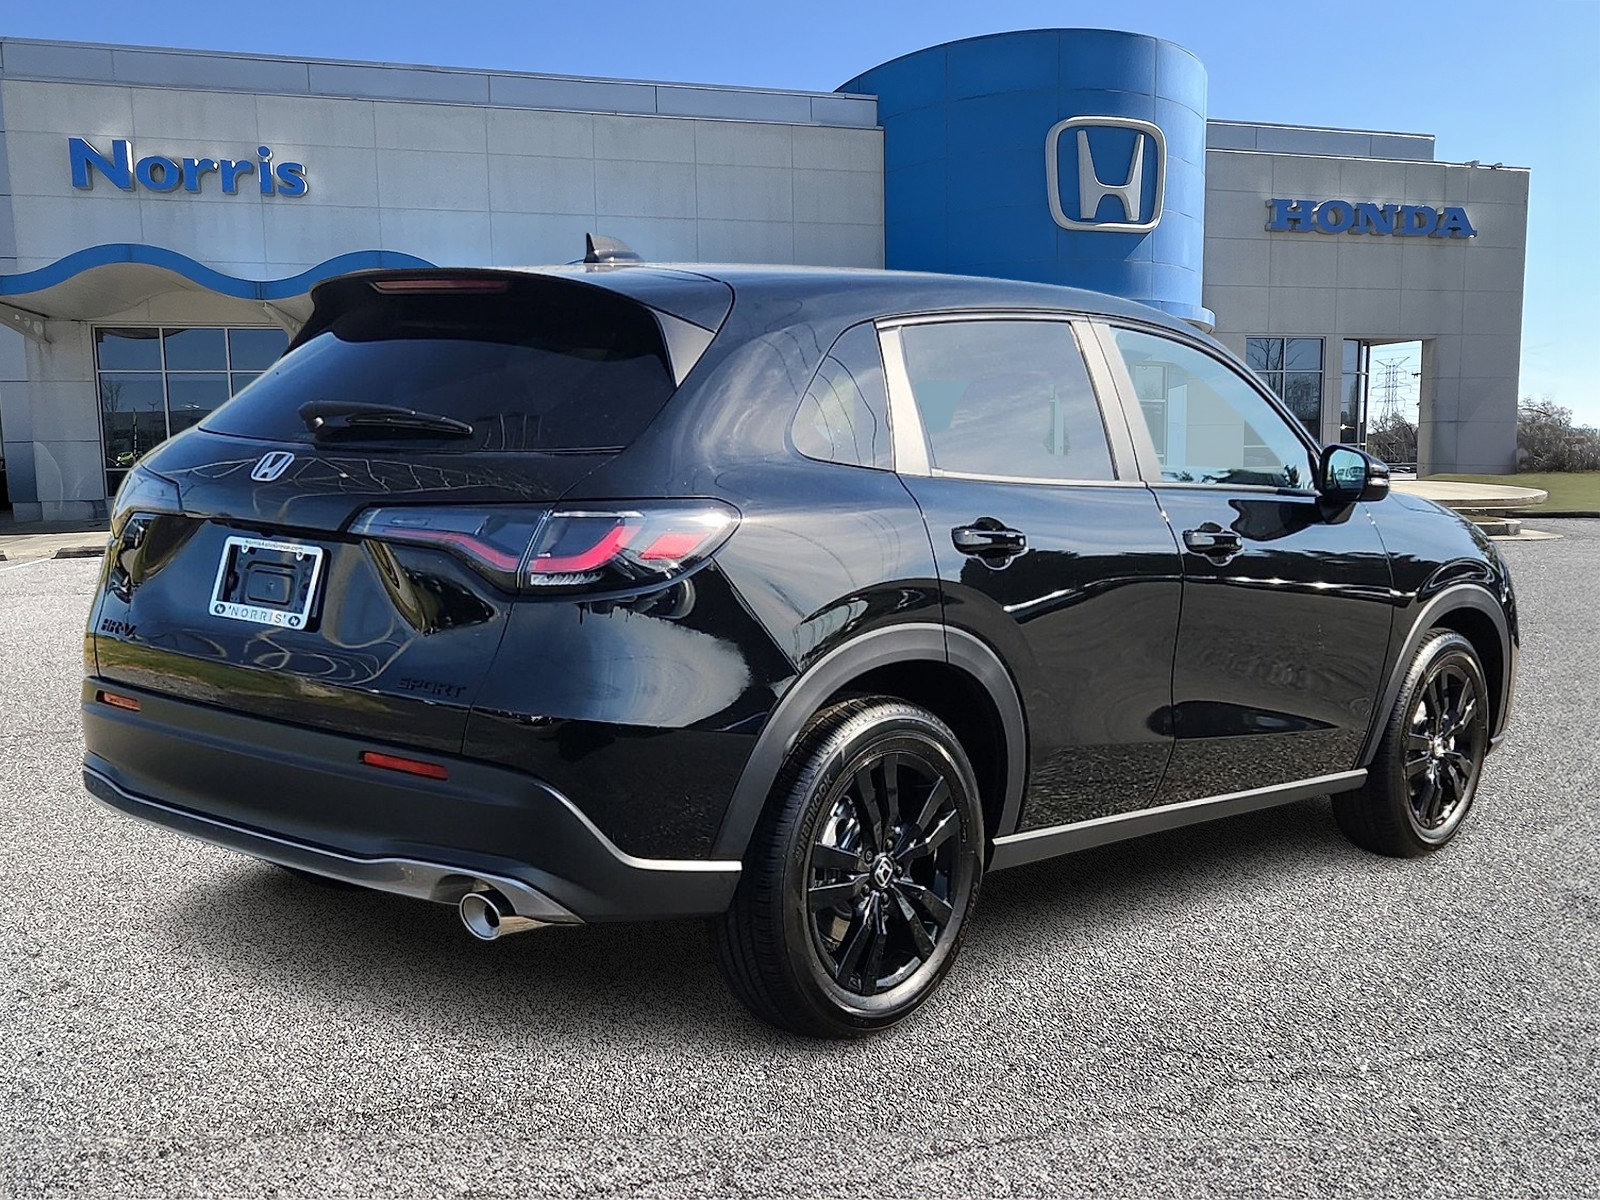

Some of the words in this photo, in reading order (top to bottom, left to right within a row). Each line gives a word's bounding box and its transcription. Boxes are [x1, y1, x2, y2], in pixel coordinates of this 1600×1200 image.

[68, 137, 309, 197] Norris
[1265, 198, 1478, 238] HONDA
[397, 678, 467, 698] SPORT
